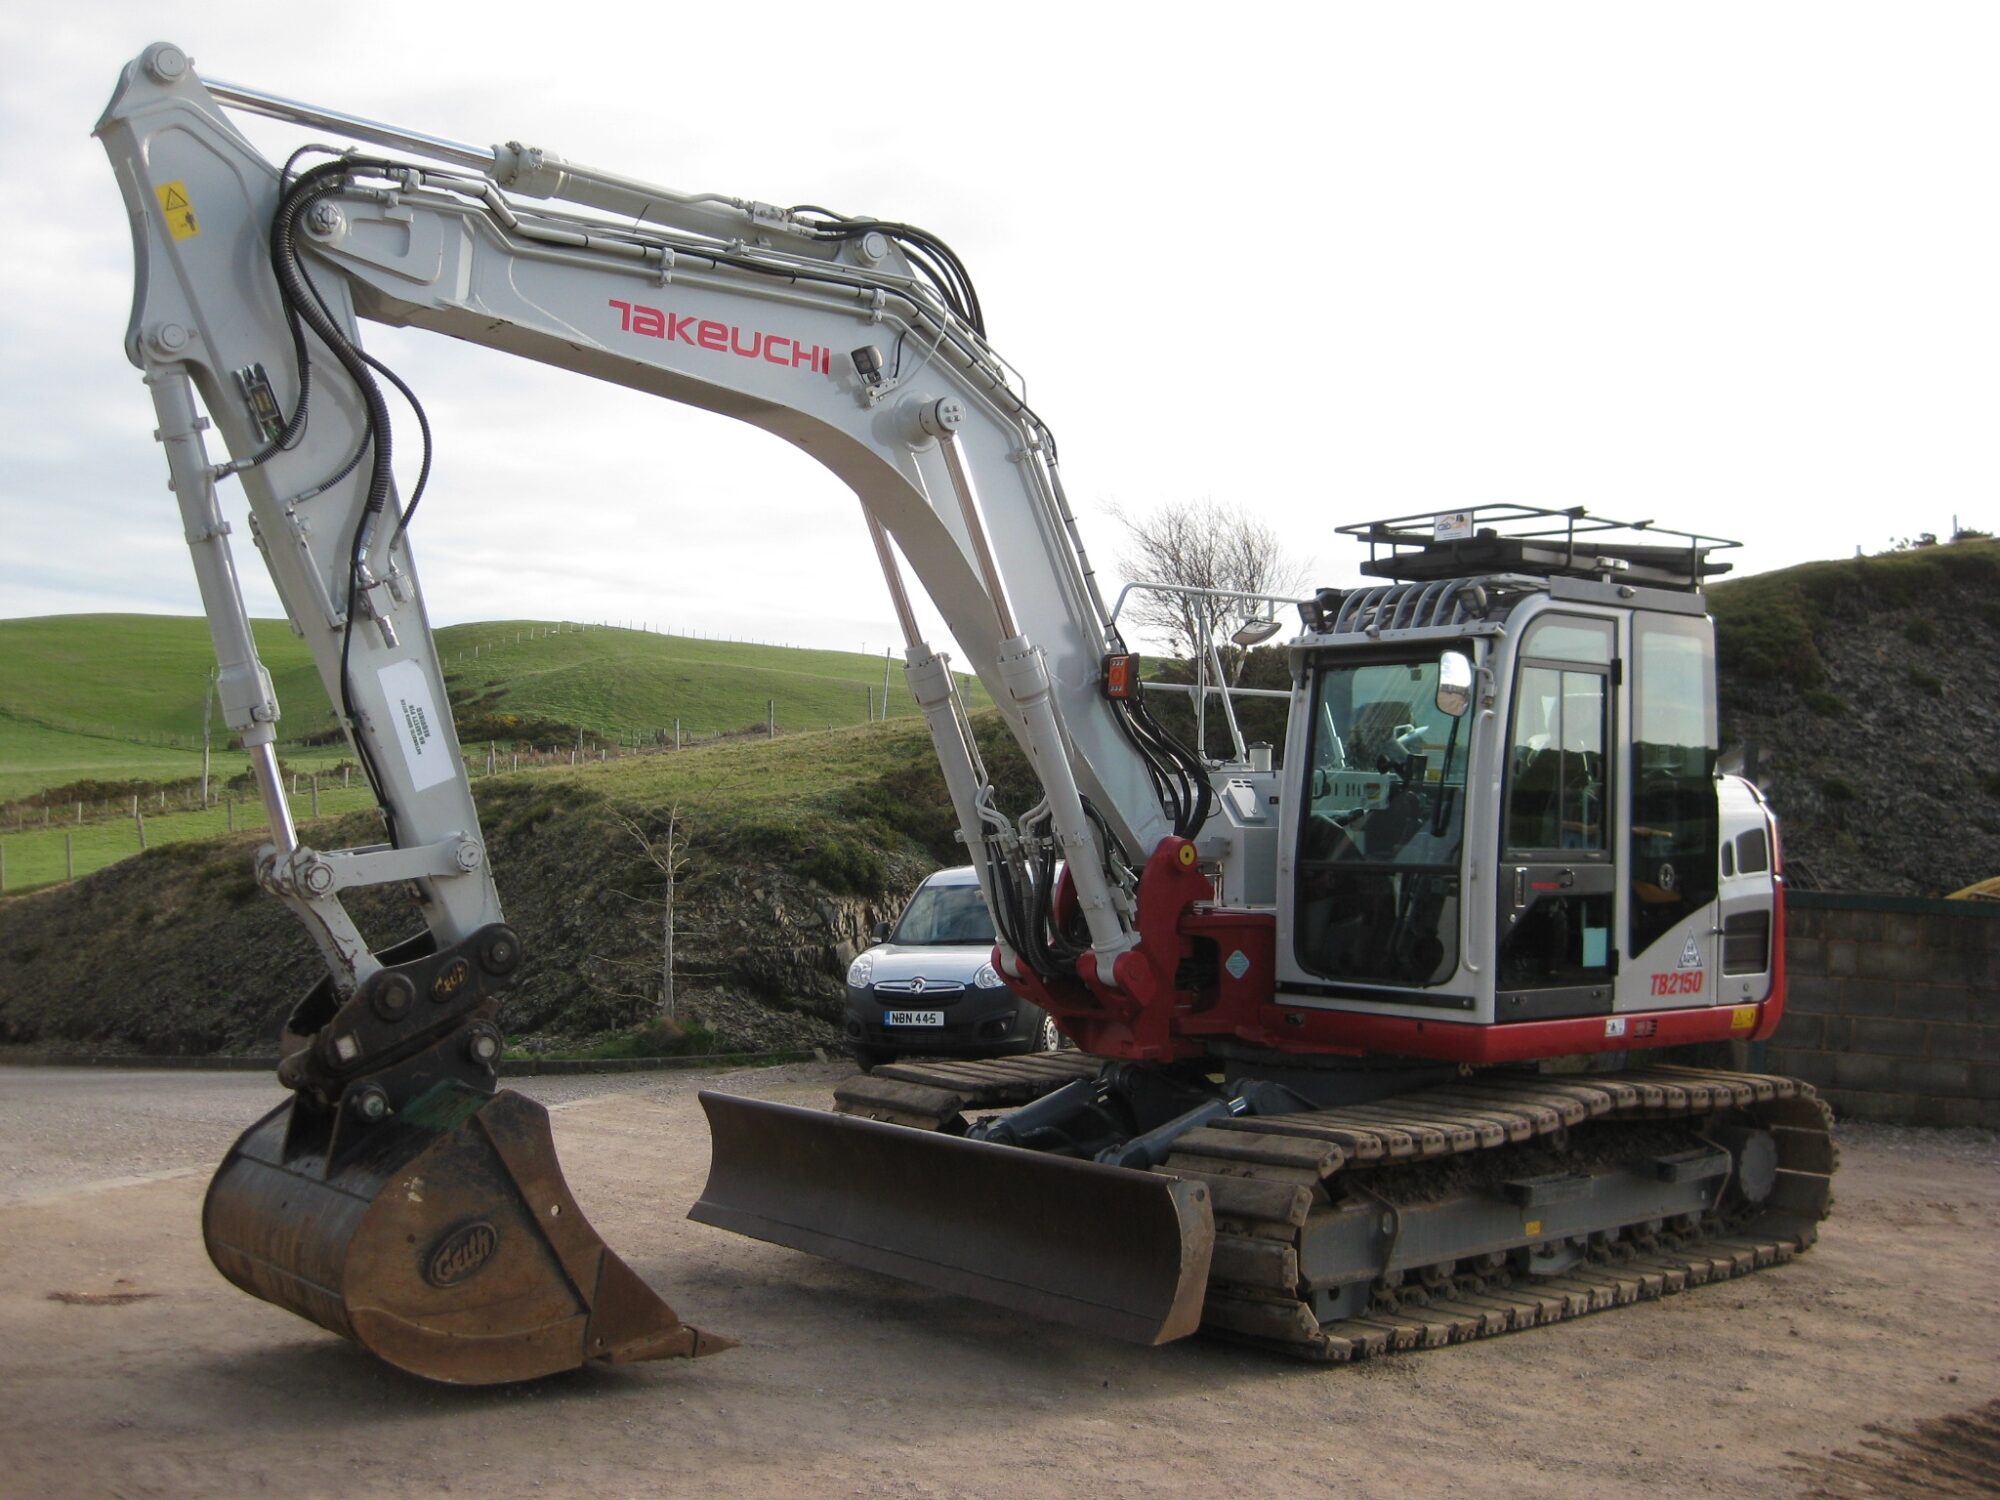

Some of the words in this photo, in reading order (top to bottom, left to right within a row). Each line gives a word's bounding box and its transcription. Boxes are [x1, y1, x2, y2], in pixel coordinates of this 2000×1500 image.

[1651, 971, 1703, 996] TB2150
[892, 1013, 913, 1024] NBN
[915, 1013, 936, 1024] 445
